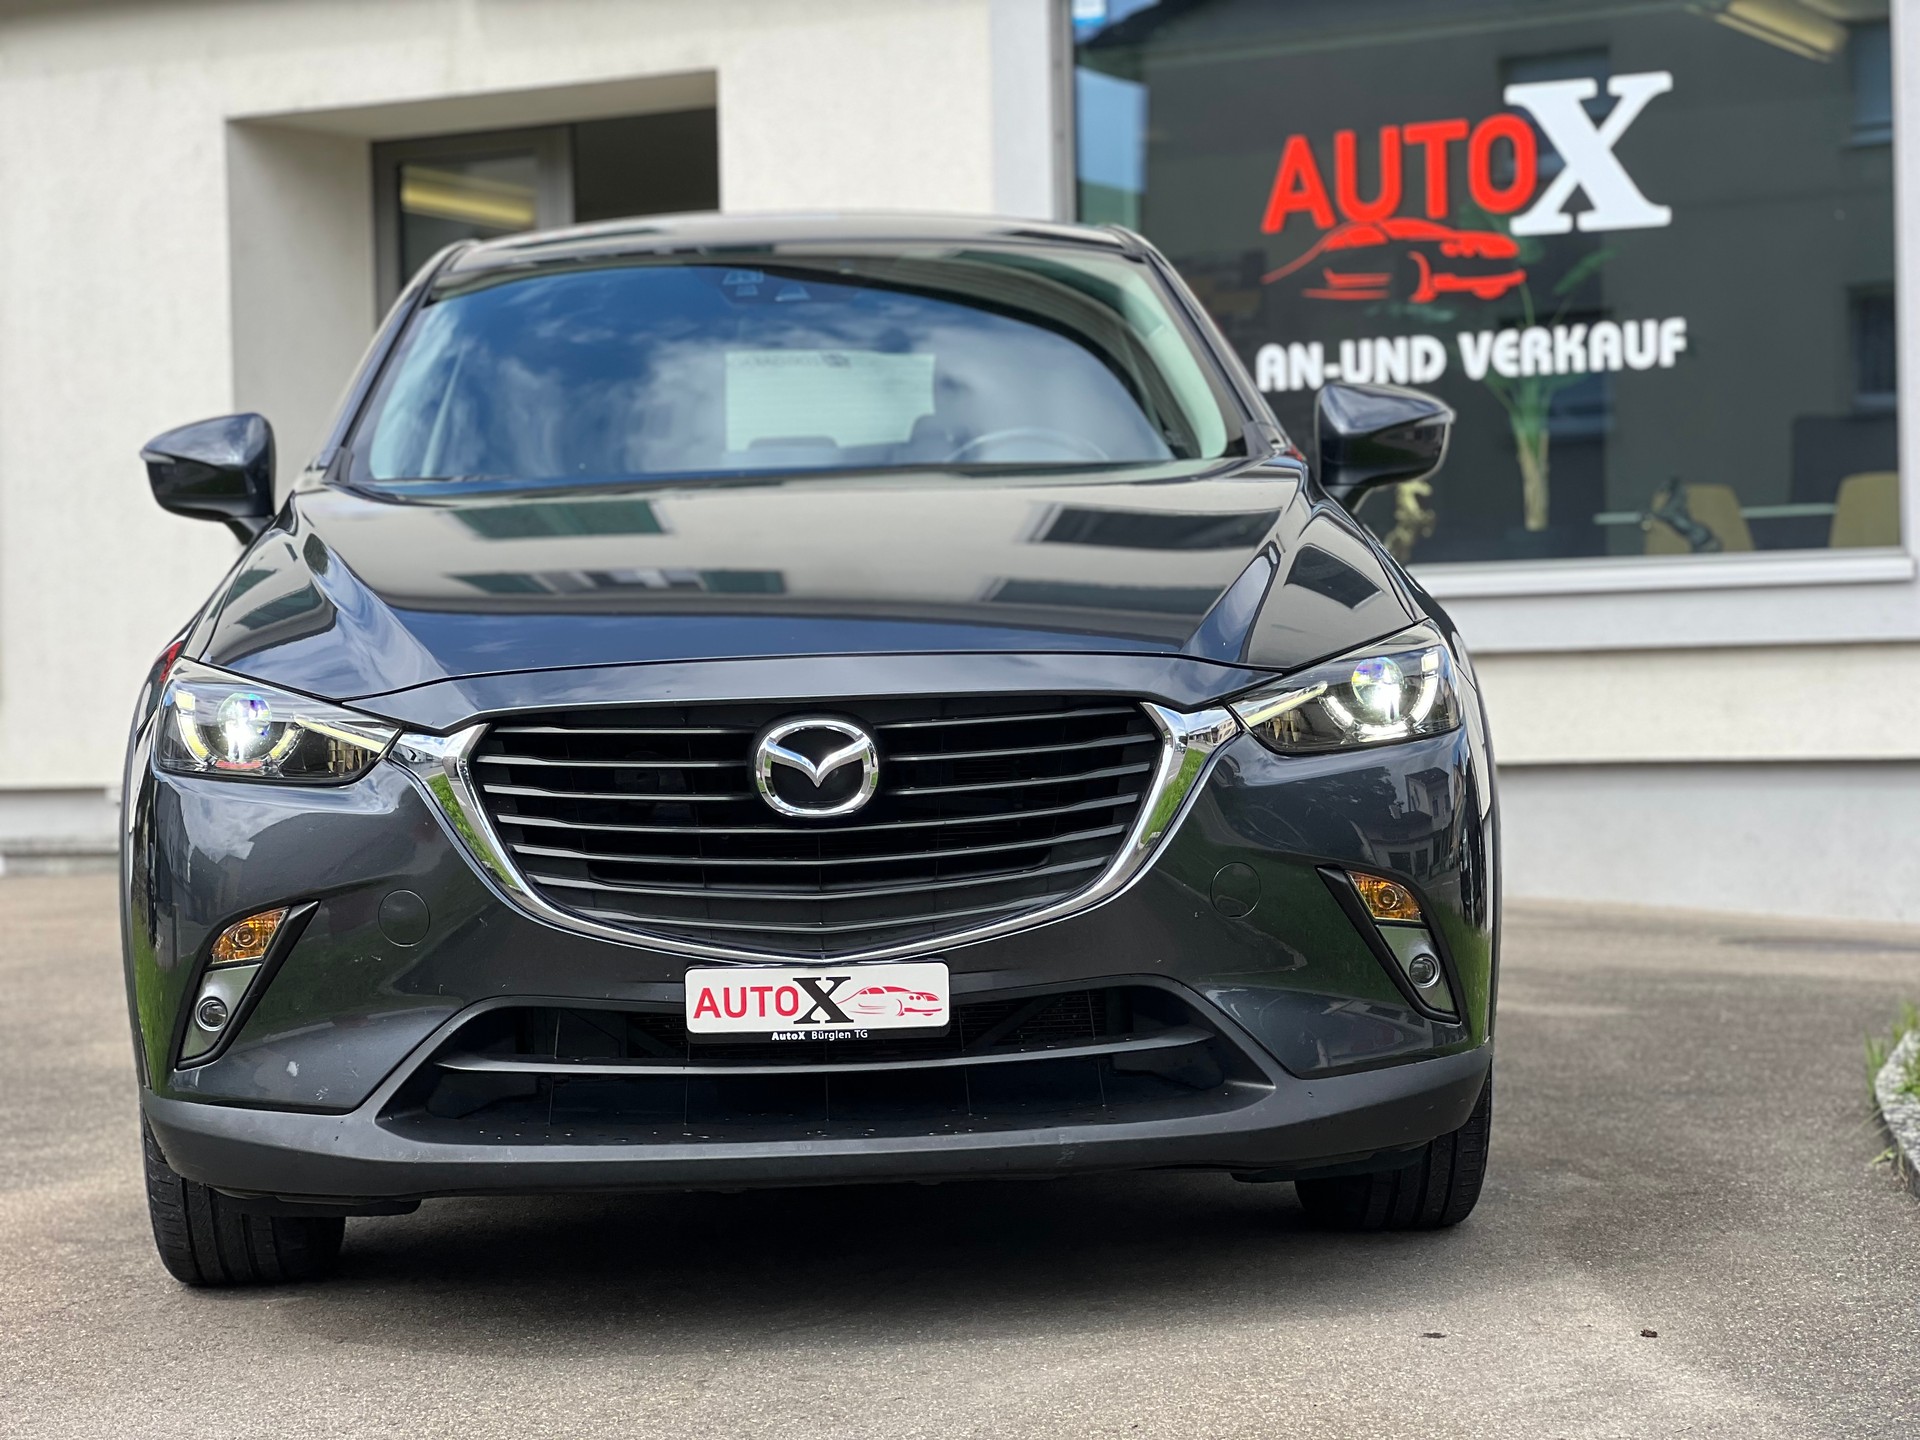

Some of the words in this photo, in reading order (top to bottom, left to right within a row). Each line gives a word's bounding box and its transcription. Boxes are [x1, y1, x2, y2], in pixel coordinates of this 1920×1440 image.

[1255, 336, 1447, 392] AN-UND
[1457, 317, 1687, 379] VERKAUF
[771, 1031, 806, 1041] AutoX
[811, 1030, 851, 1042] Bürglen
[854, 1029, 868, 1039] TG
